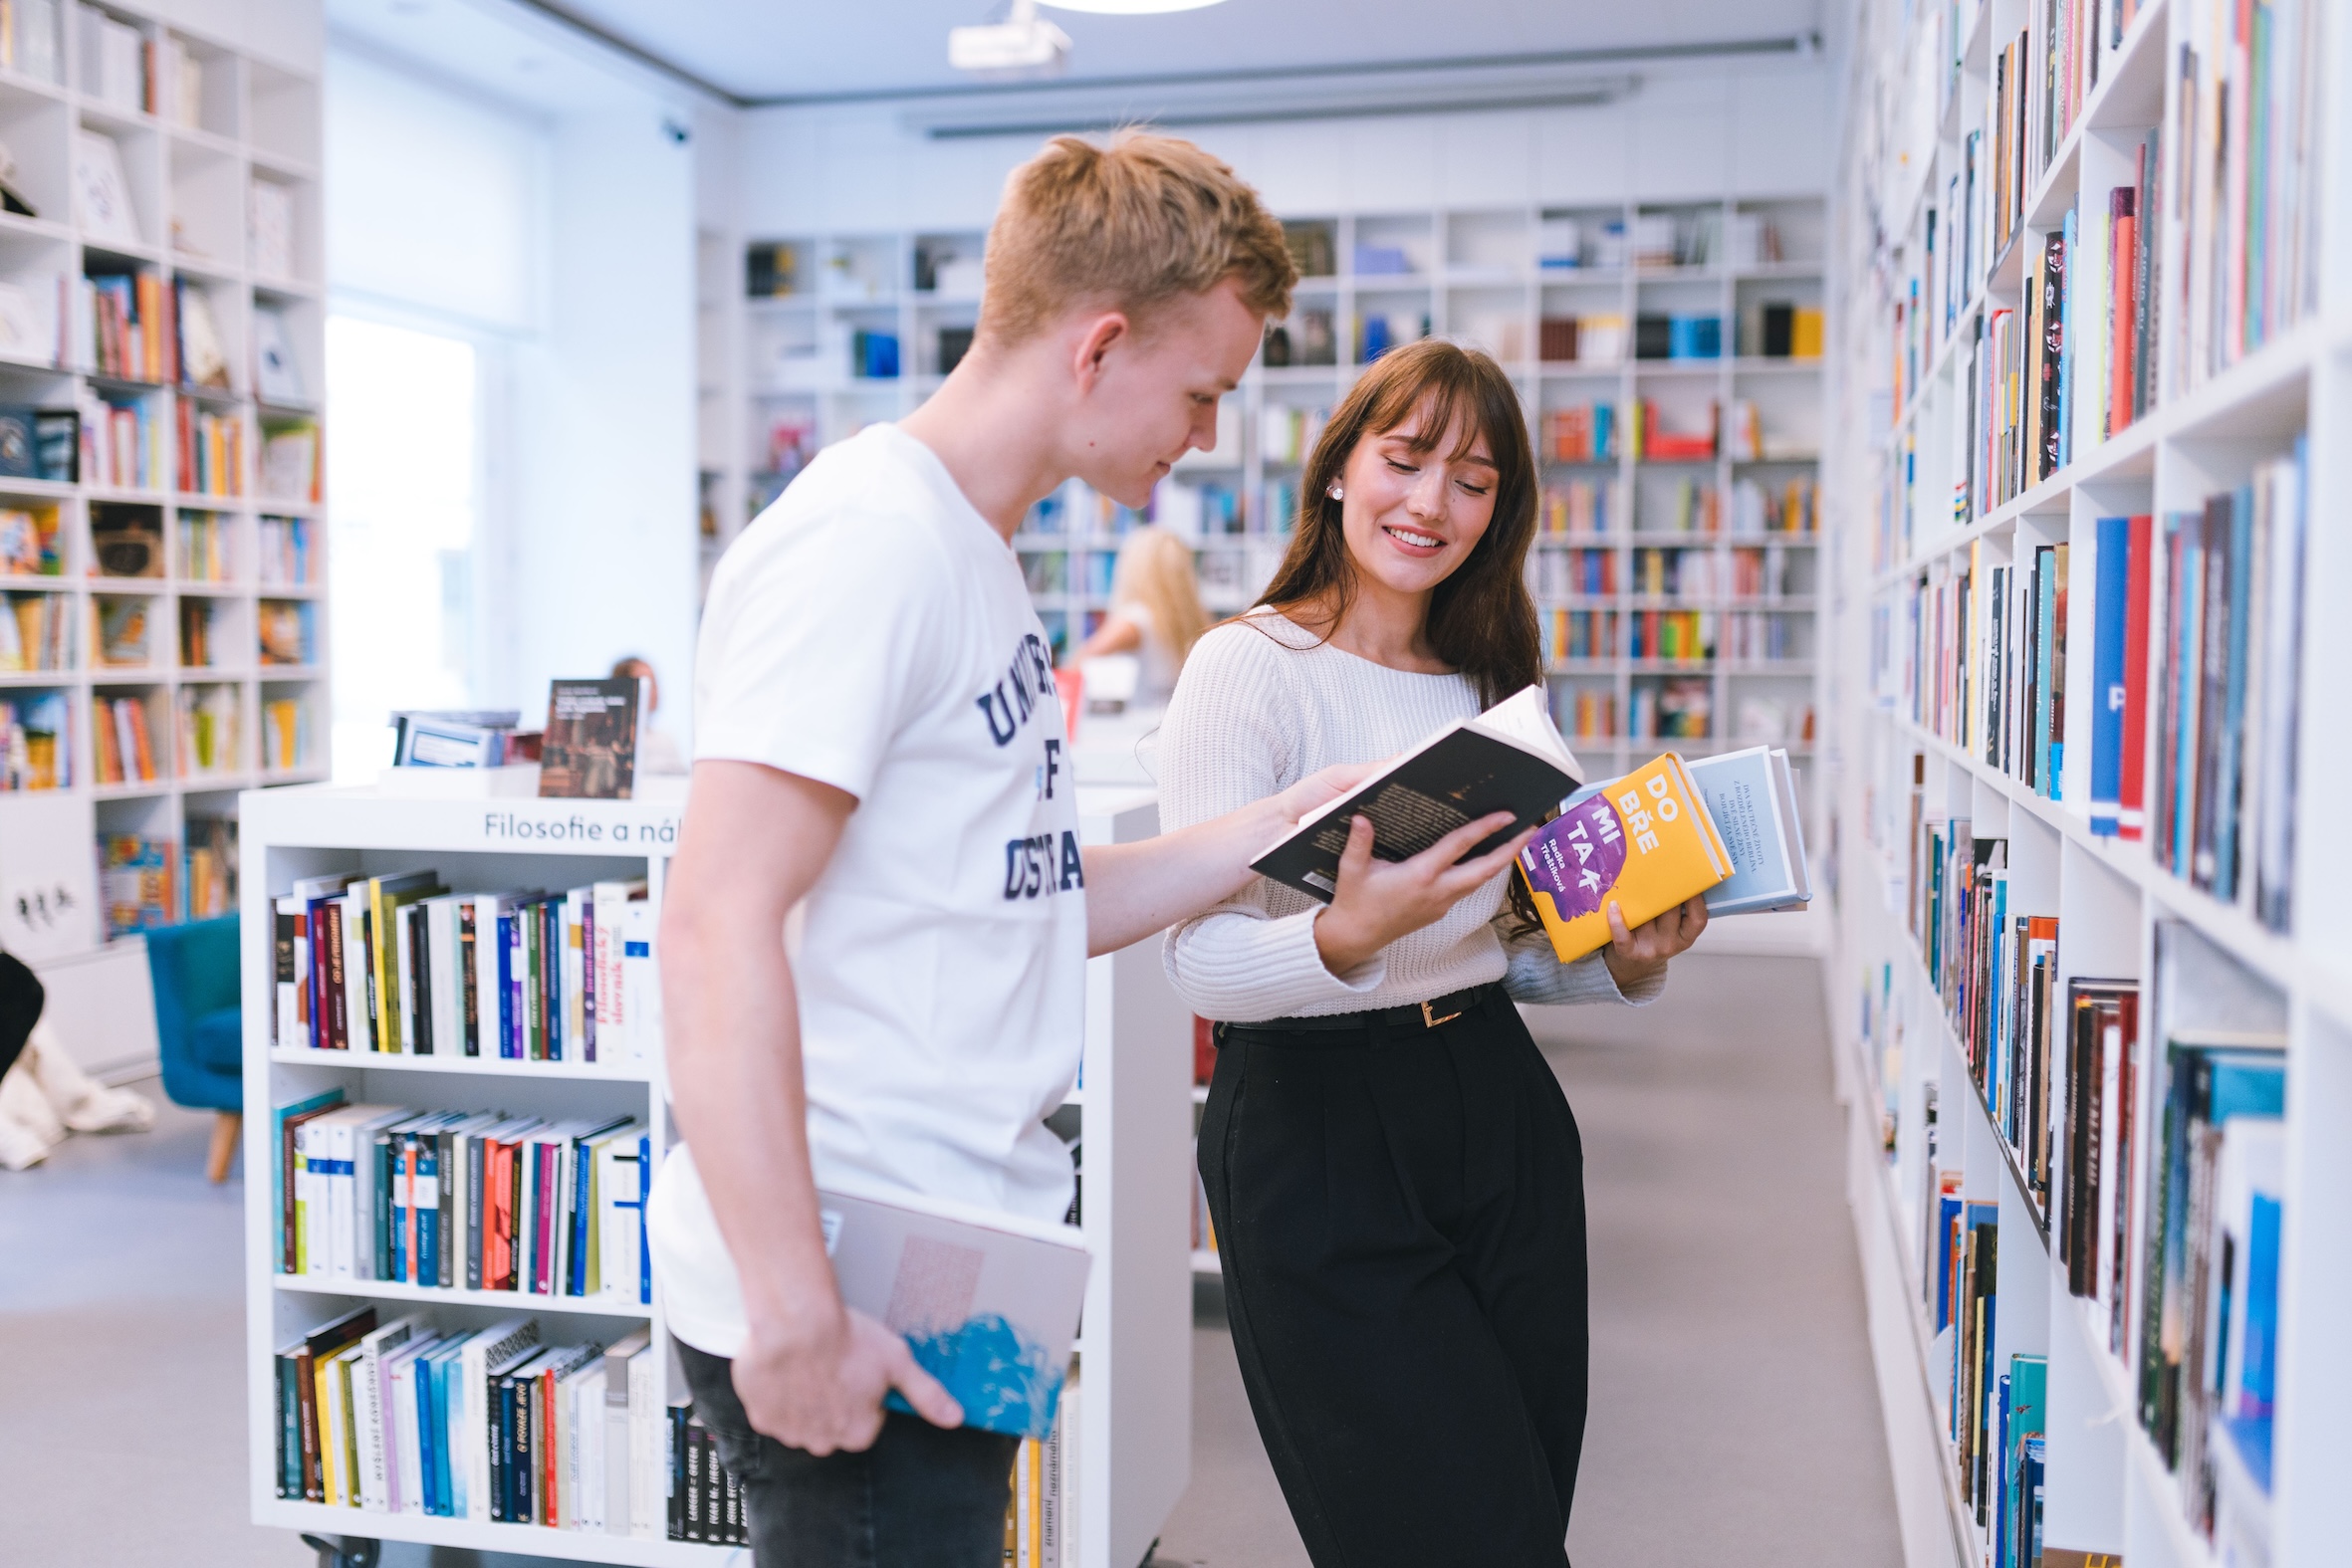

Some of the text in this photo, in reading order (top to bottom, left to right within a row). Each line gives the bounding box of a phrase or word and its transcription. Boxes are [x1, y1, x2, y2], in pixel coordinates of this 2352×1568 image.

[1618, 789, 1660, 855] BŘE
[1645, 774, 1678, 822] DO
[1719, 792, 1731, 824] BOJUJÍCÍ
[1735, 785, 1750, 840] ROZDĚLENÉHO
[485, 812, 602, 840] Filosofie
[612, 824, 628, 841] a
[1591, 805, 1621, 844] MI
[1726, 825, 1733, 835] ZA
[1728, 836, 1737, 850] SVÉ
[1729, 799, 1746, 857] DVĚ SILNÉ ŽENY
[1747, 800, 1759, 837] SKUTEČNÉ
[1754, 838, 1764, 865] ŽIVOTY
[1540, 843, 1566, 893] Třeštíková
[1548, 838, 1565, 869] Radka
[1567, 820, 1601, 894] TAK
[708, 1500, 719, 1525] IVAN
[1042, 1498, 1054, 1547] znamení
